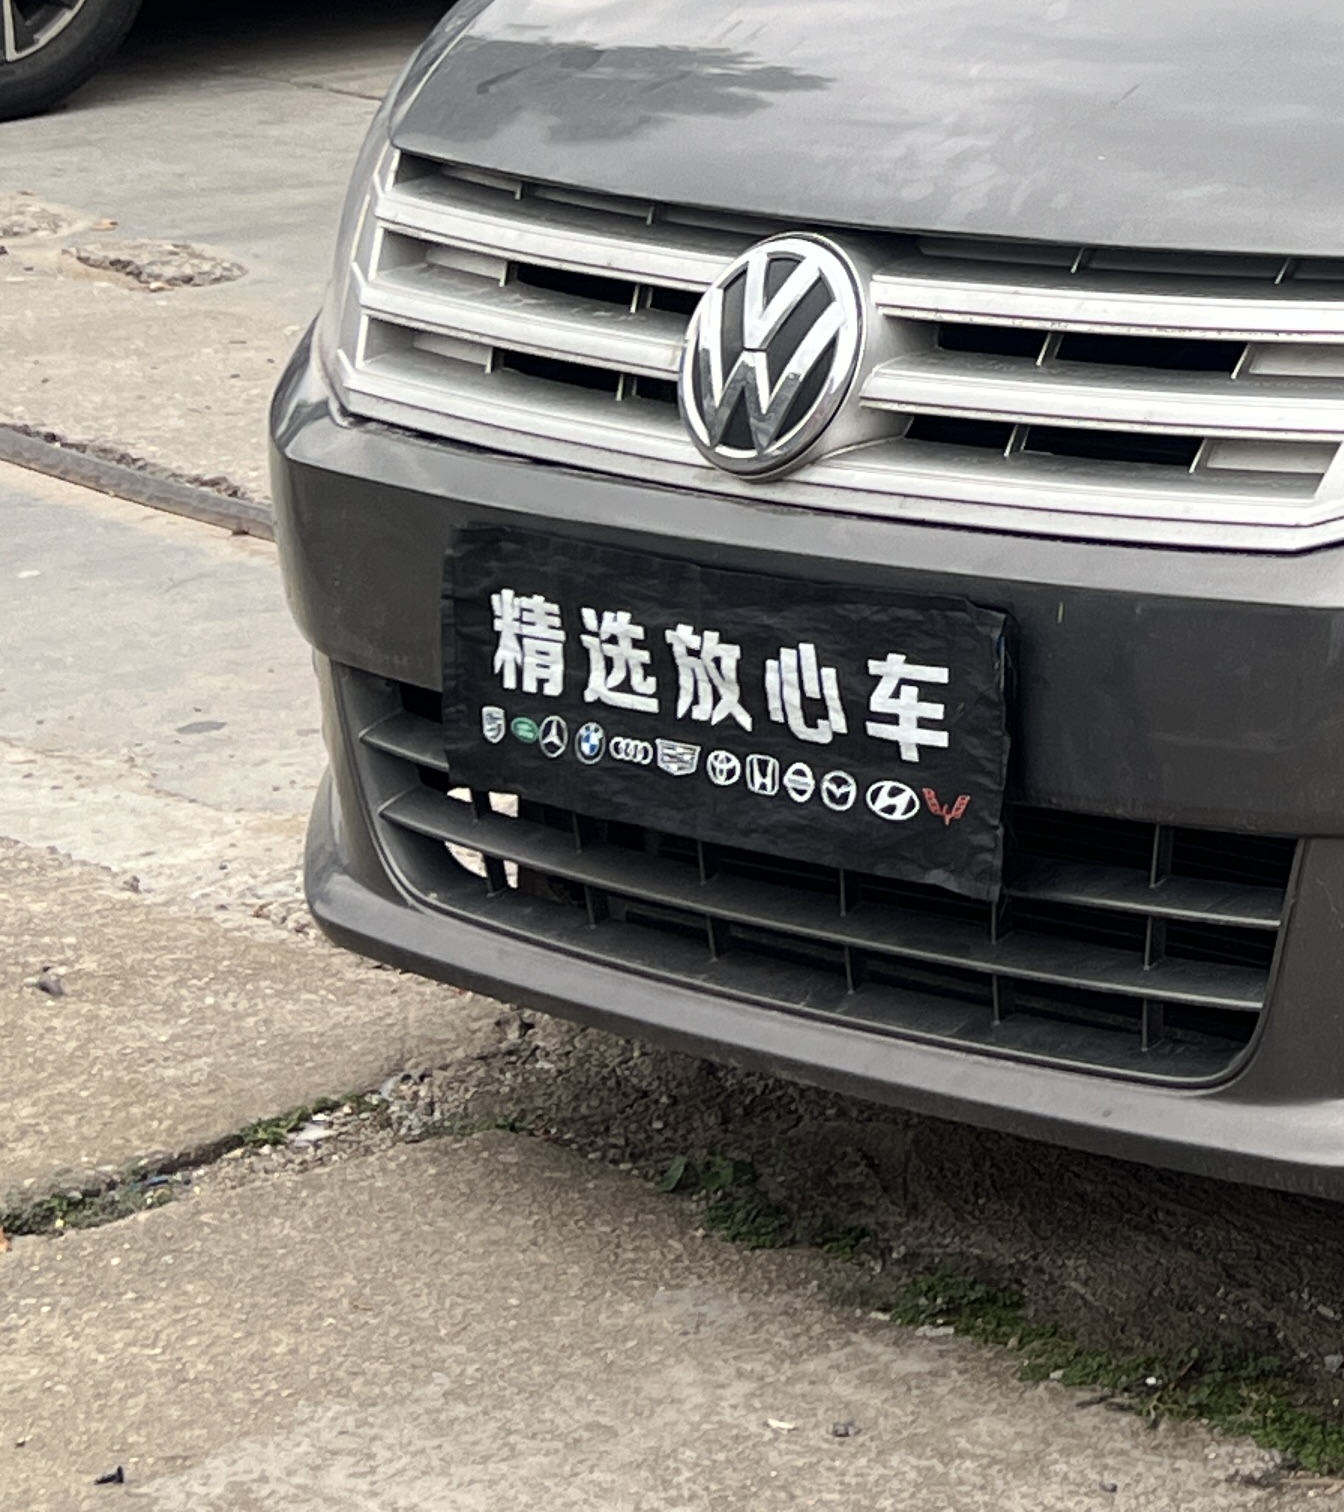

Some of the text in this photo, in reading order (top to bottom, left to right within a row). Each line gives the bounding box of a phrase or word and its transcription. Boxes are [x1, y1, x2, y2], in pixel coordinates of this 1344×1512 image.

[490, 588, 950, 763] 精选放心车
